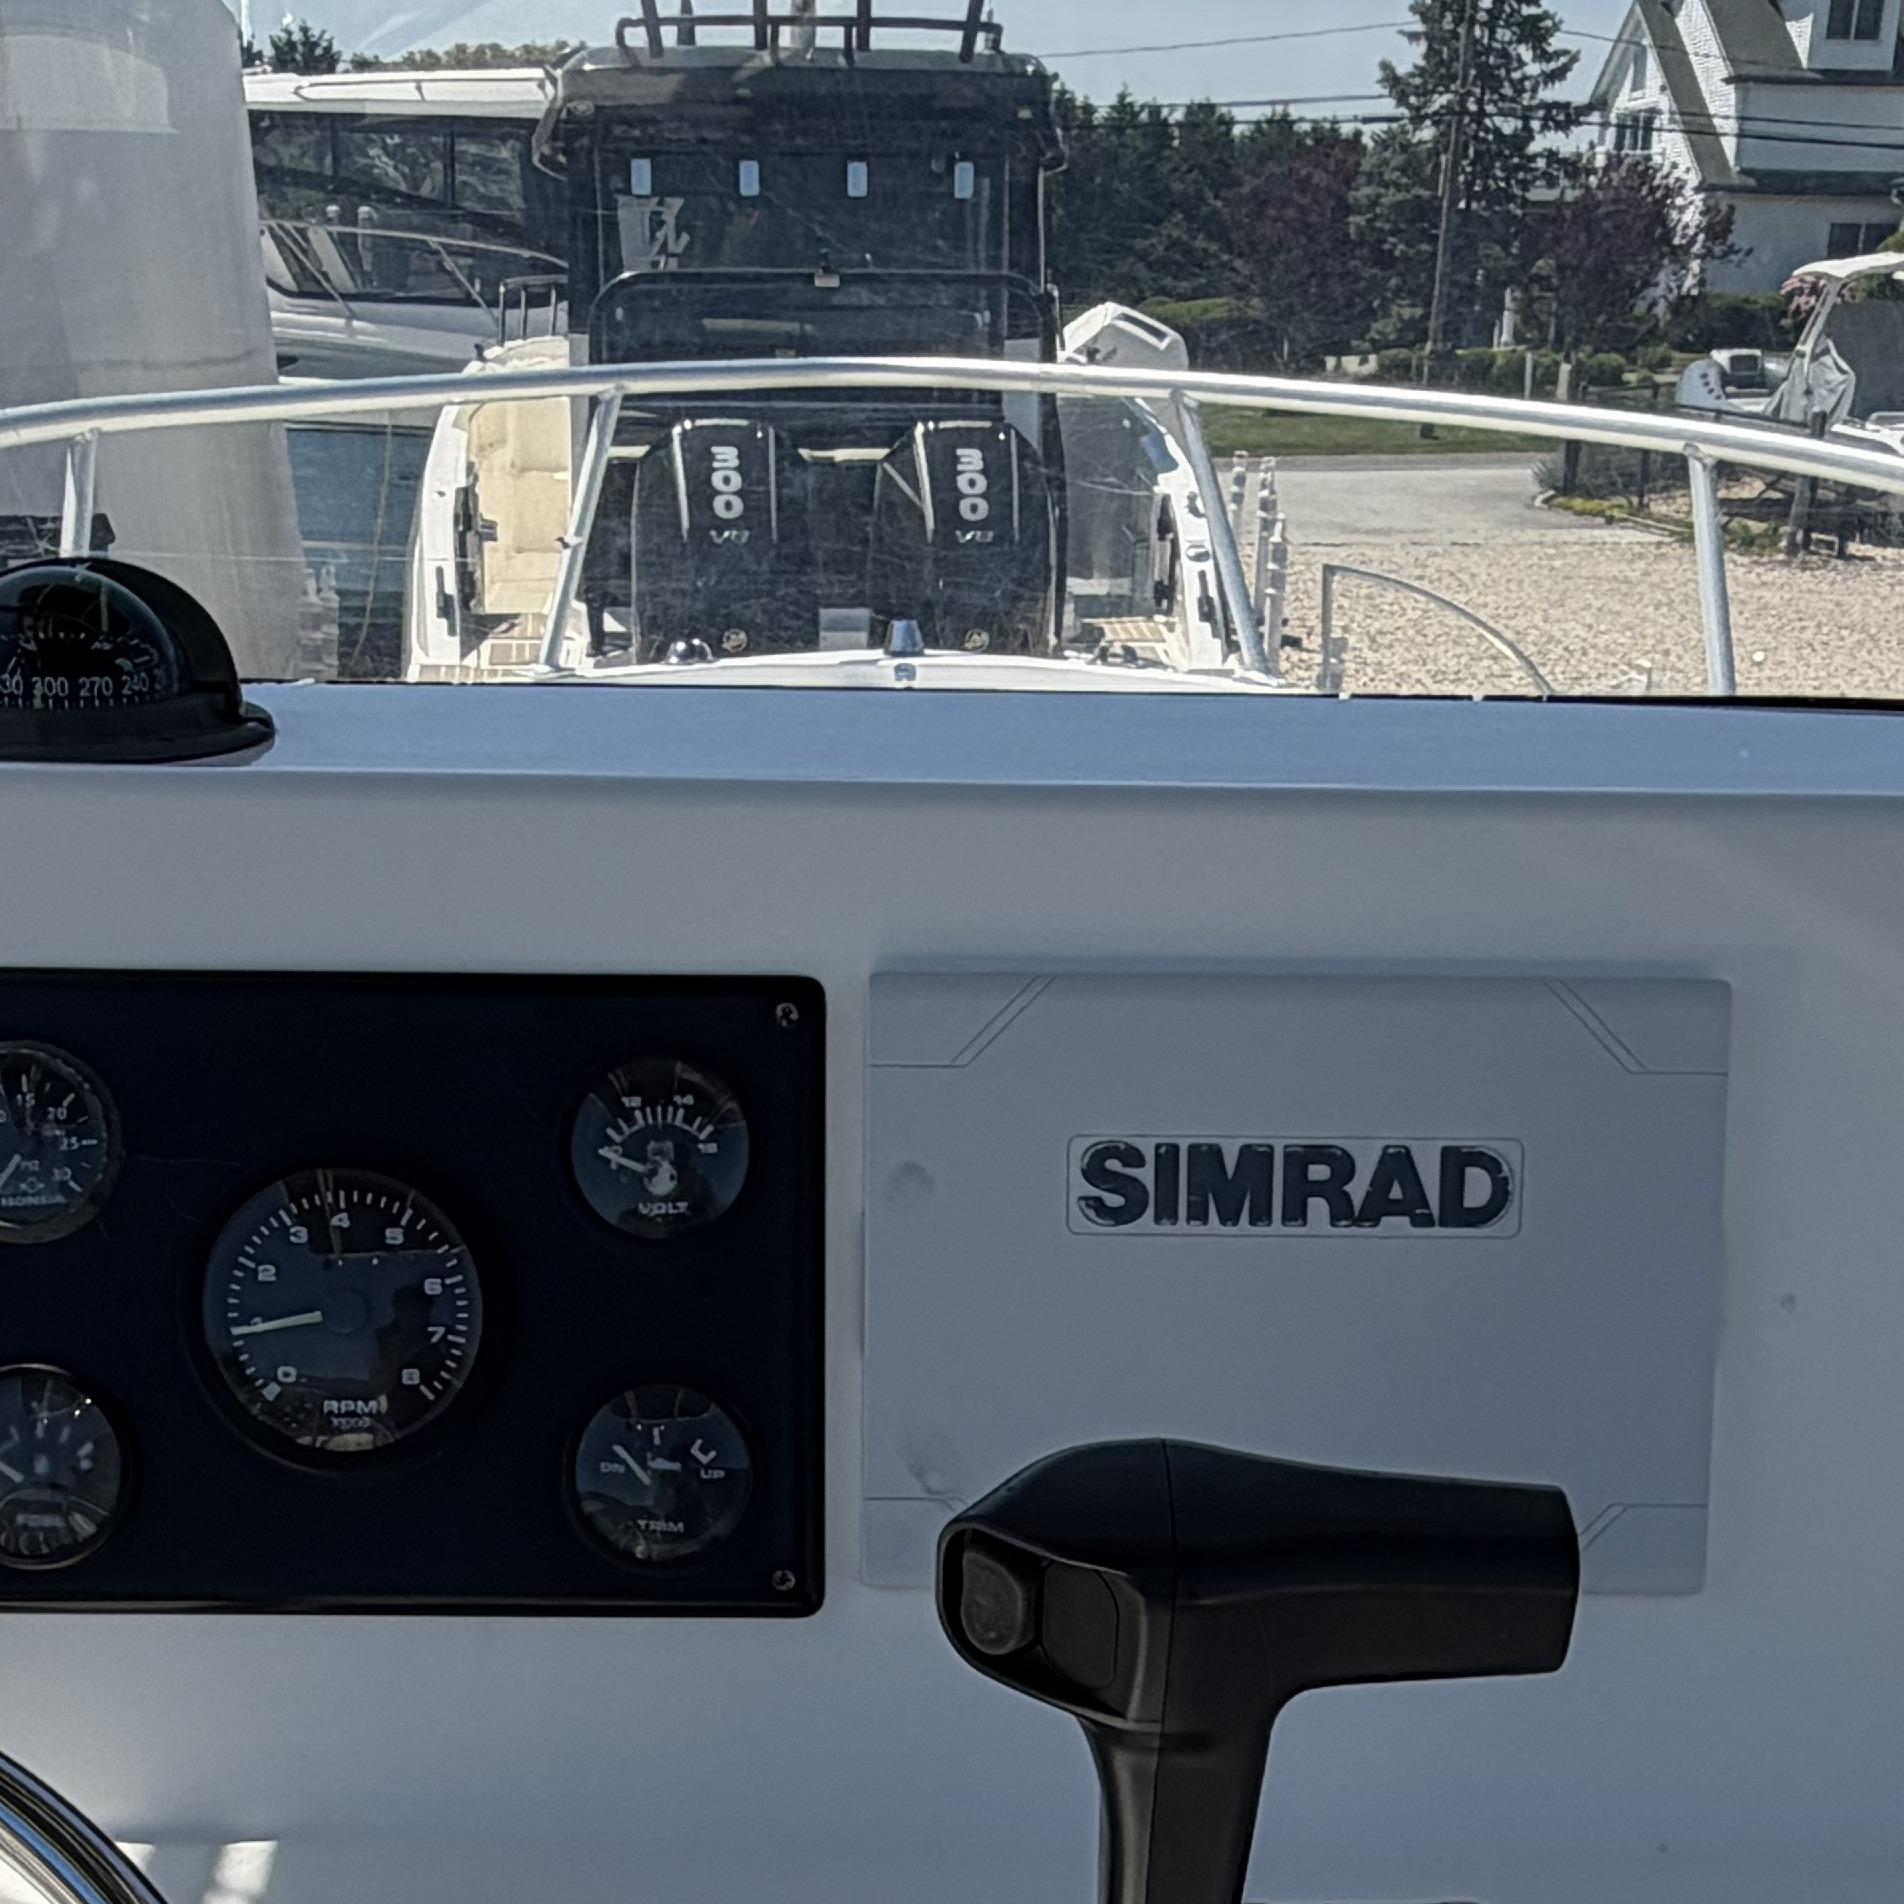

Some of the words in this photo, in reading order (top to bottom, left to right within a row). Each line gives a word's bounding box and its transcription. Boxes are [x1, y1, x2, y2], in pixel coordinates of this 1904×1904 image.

[710, 445, 745, 520] 300
[955, 447, 990, 521] 300
[78, 676, 114, 698] 270
[1076, 1138, 1515, 1229] SIMRAD
[330, 1212, 351, 1229] 4
[289, 1226, 309, 1245] 3
[384, 1226, 405, 1246] 5
[257, 1263, 278, 1282] 2
[423, 1277, 444, 1297] 6
[427, 1326, 447, 1344] 7
[276, 1365, 297, 1383] 0
[400, 1367, 421, 1386] 8
[323, 1399, 378, 1415] RPM
